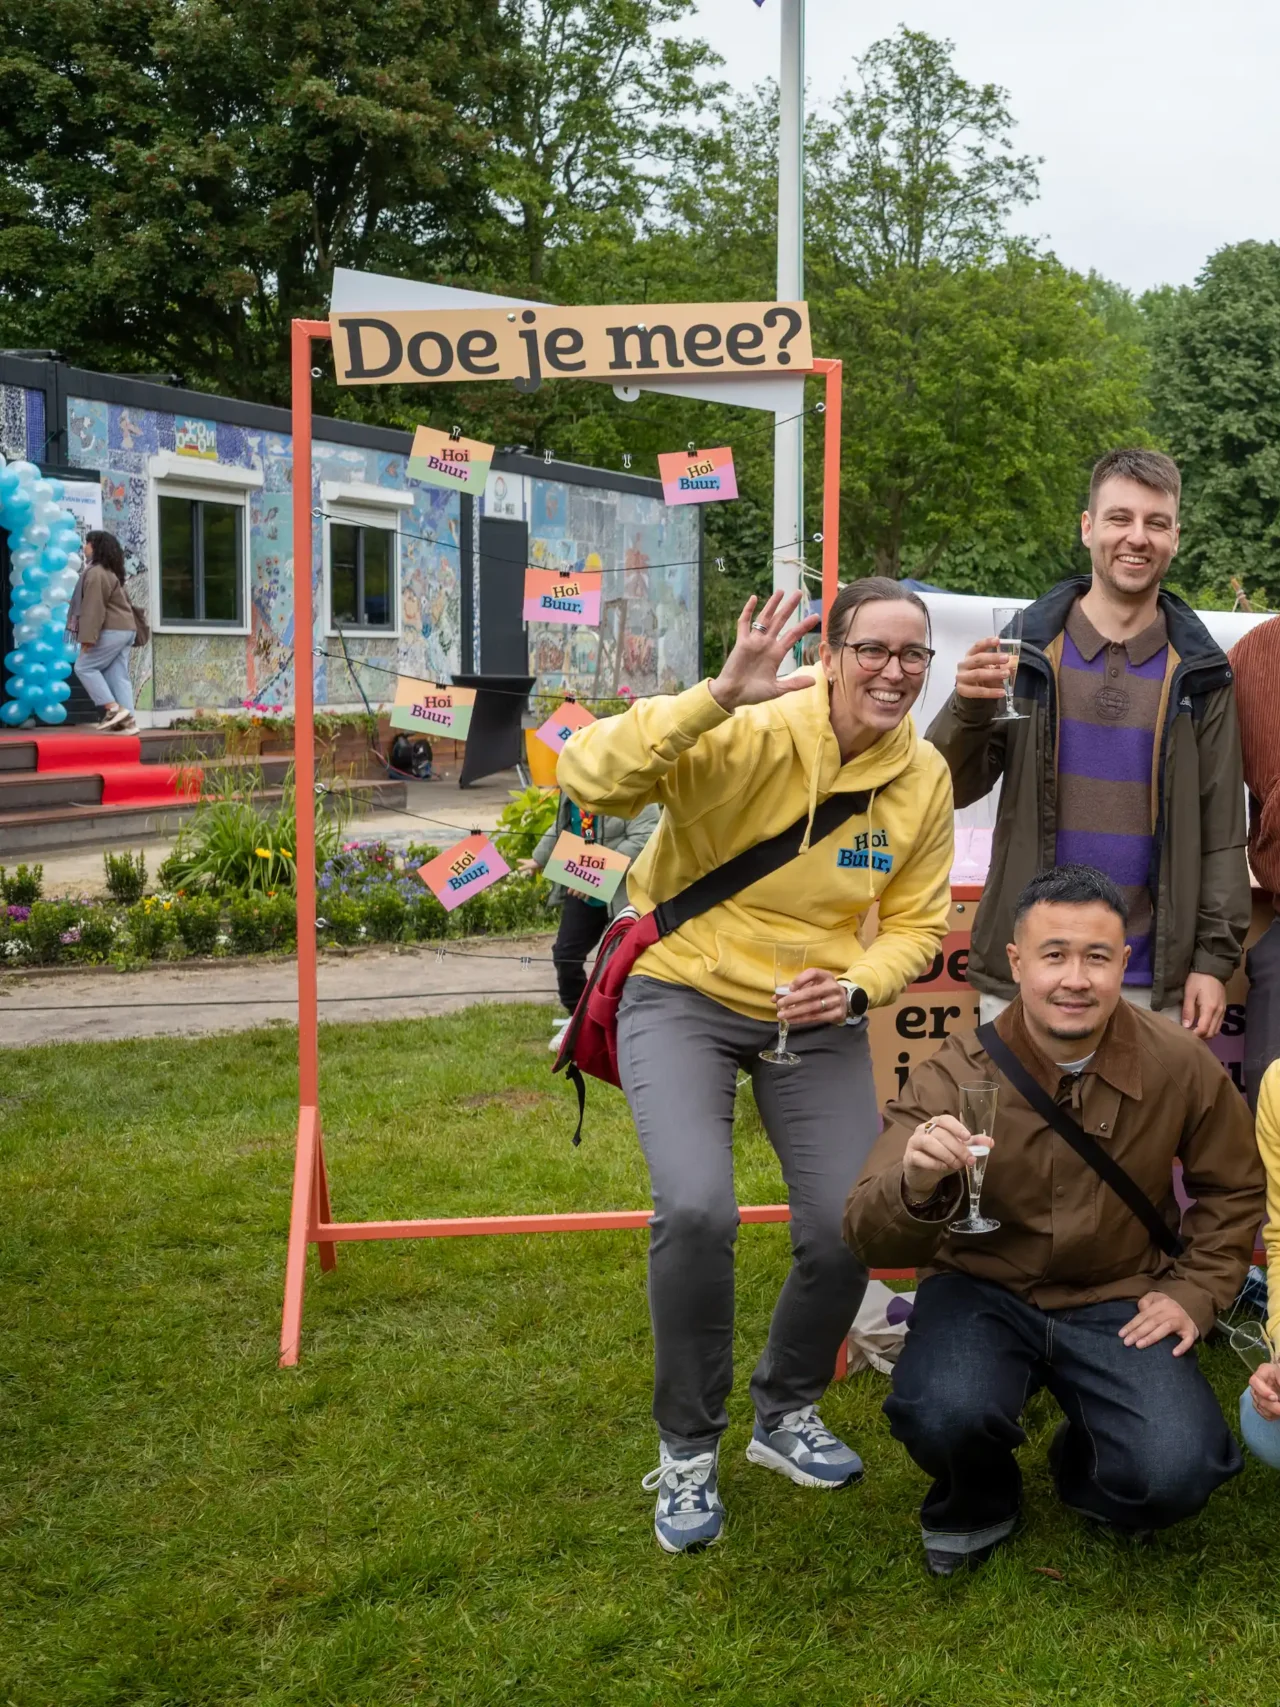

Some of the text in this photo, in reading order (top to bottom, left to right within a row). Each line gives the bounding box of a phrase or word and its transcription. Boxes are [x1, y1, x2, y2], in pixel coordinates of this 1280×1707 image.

[338, 307, 803, 394] Doe je mee?
[442, 449, 470, 462] Hoi
[428, 456, 468, 482] Buur,
[687, 460, 714, 479] Hoi
[680, 478, 720, 491] Buur,
[553, 583, 580, 598] Hoi
[541, 596, 582, 616] Buur,
[424, 695, 453, 709] Hoi
[411, 704, 452, 728] Buur,
[854, 829, 889, 852] Hoi
[450, 851, 476, 876] Hoi
[579, 855, 606, 870] Hoi
[838, 849, 890, 875] Buur,
[448, 865, 490, 891] Buur,
[564, 860, 601, 888] Buur,
